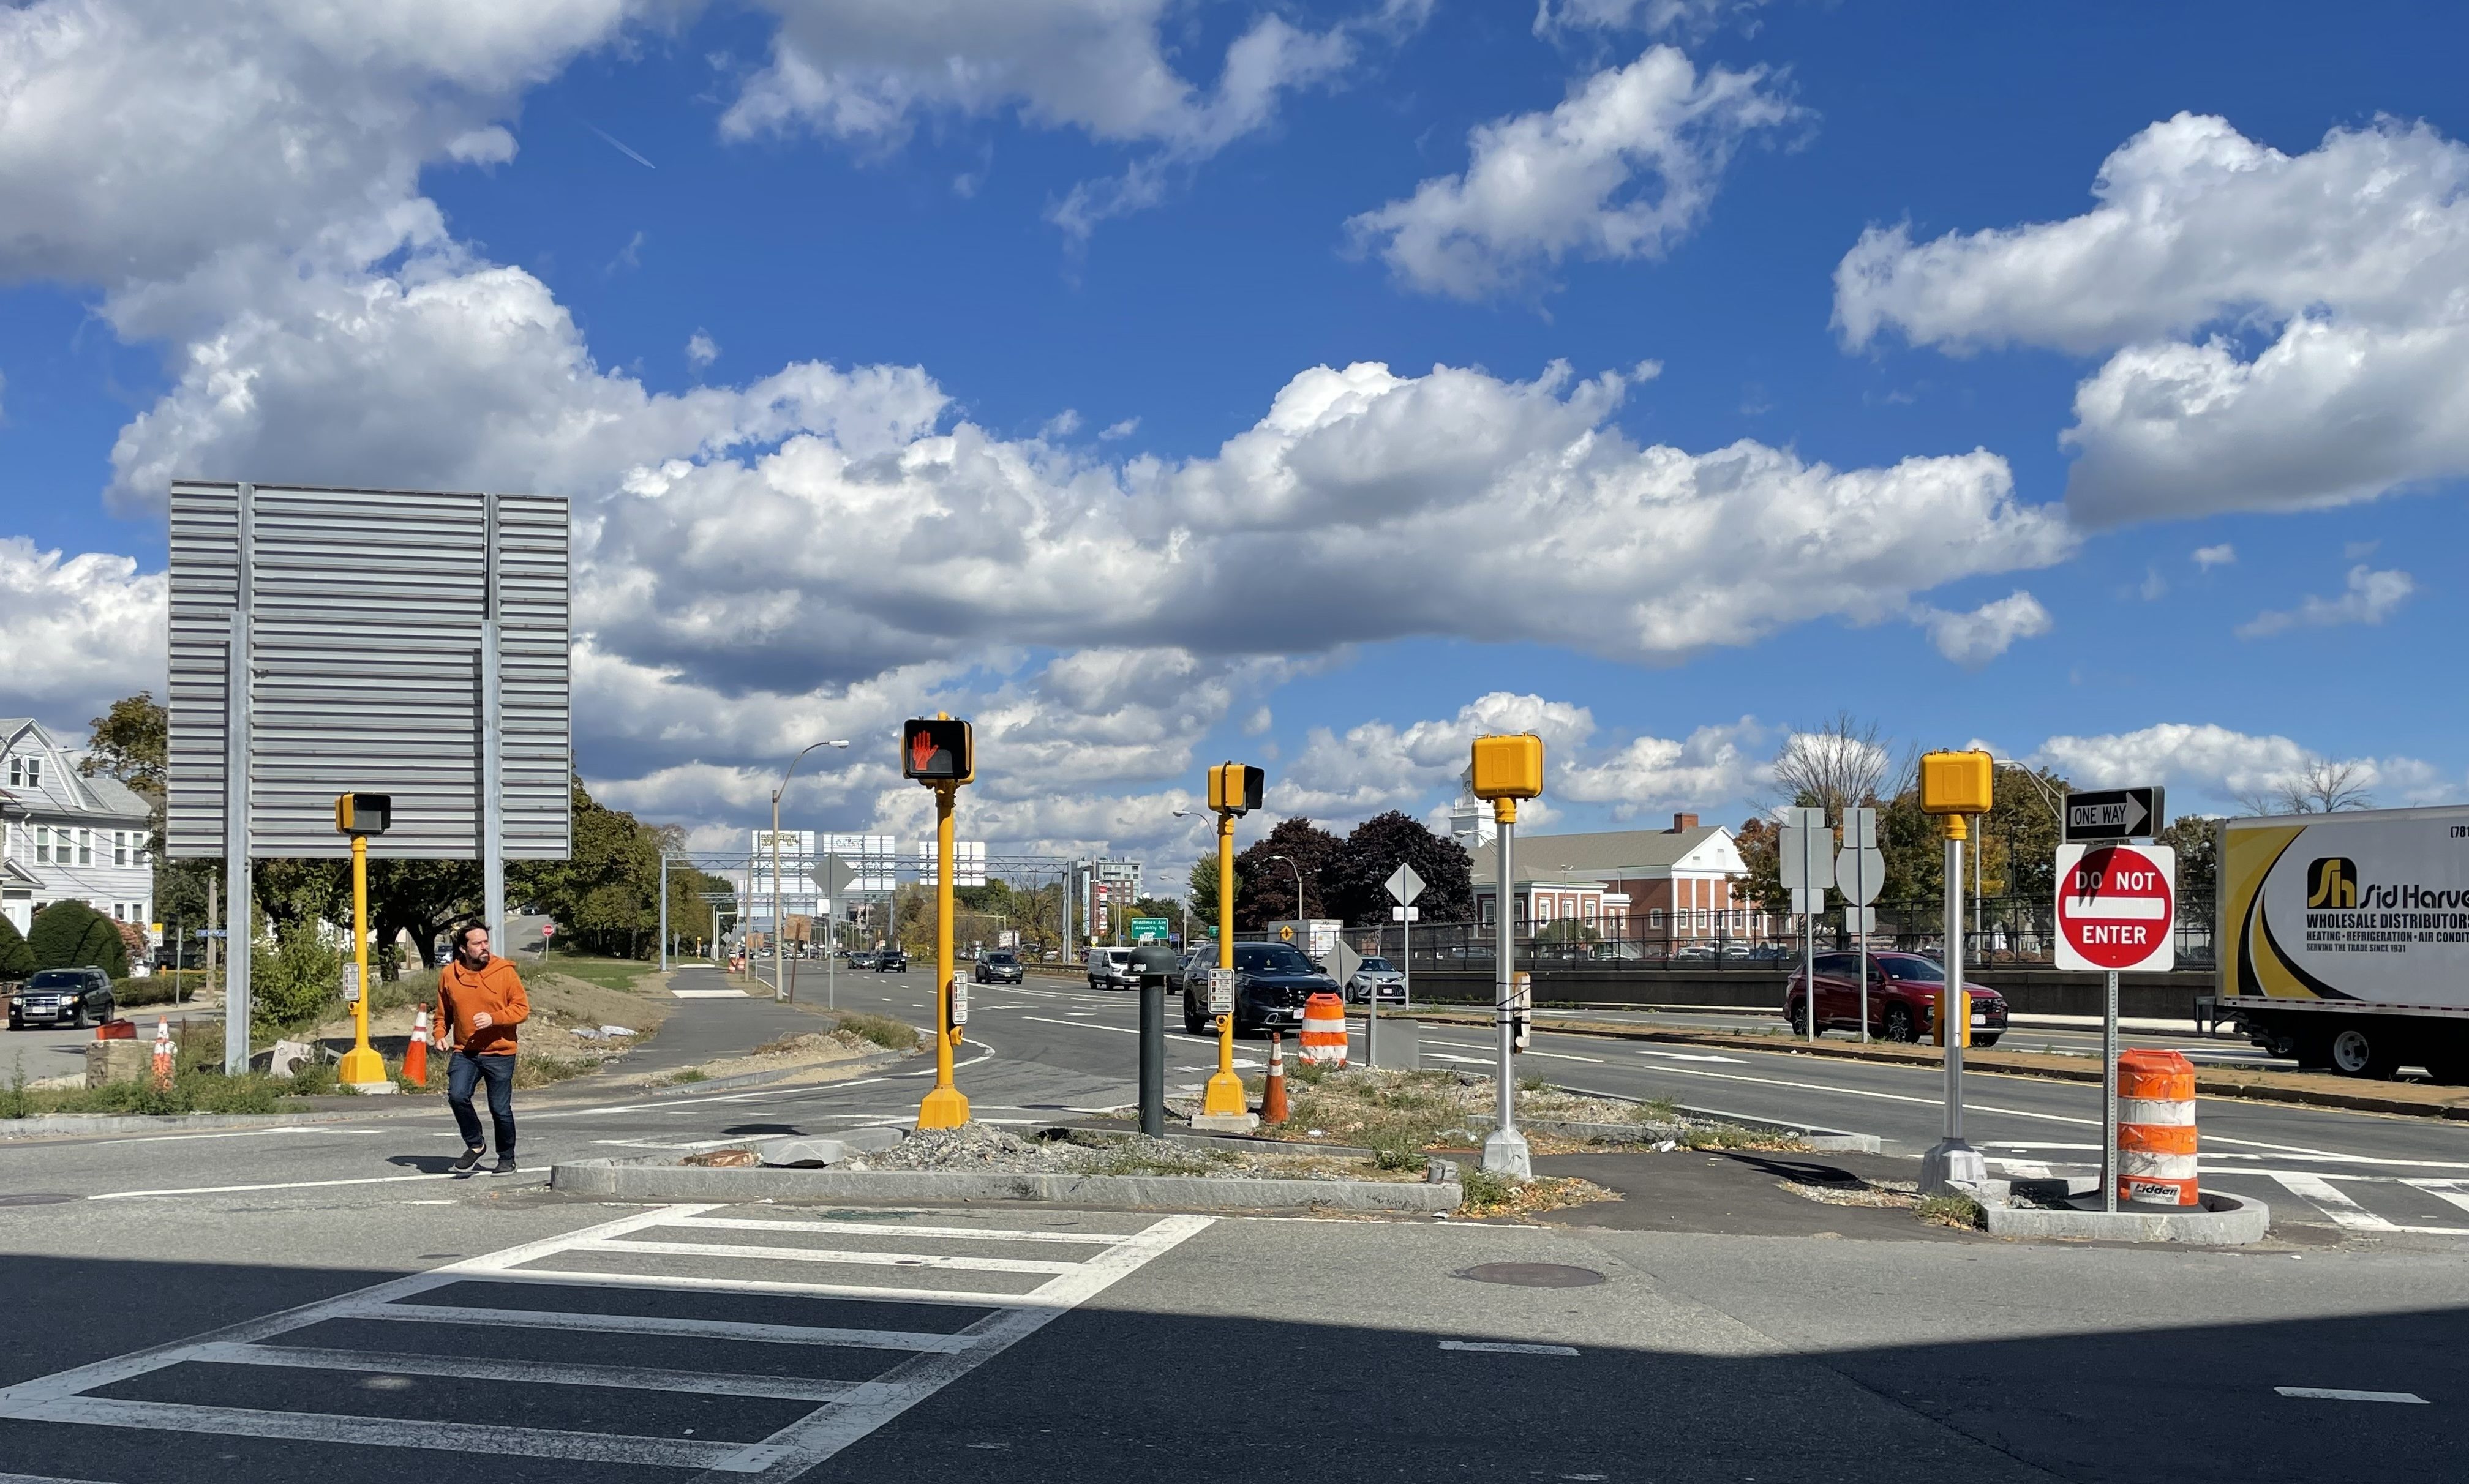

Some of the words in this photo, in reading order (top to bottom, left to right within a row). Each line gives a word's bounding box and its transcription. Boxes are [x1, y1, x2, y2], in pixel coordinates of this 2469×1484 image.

[2075, 808, 2097, 825] ONE
[2103, 804, 2127, 823] WAY
[2076, 871, 2102, 890] DO
[2116, 872, 2155, 890] NOT
[2359, 884, 2398, 909] Sid
[2307, 914, 2377, 929] WHOLESALE
[2380, 913, 2469, 929] DISTRIBUTOR
[2083, 926, 2146, 945] ENTER
[2307, 931, 2340, 941] HEATING
[2347, 931, 2412, 942] REFRIGERATION
[2418, 932, 2433, 942] AIR
[2348, 943, 2368, 952] TRADE
[2369, 944, 2389, 953] SINCE
[2391, 944, 2406, 953] 1931
